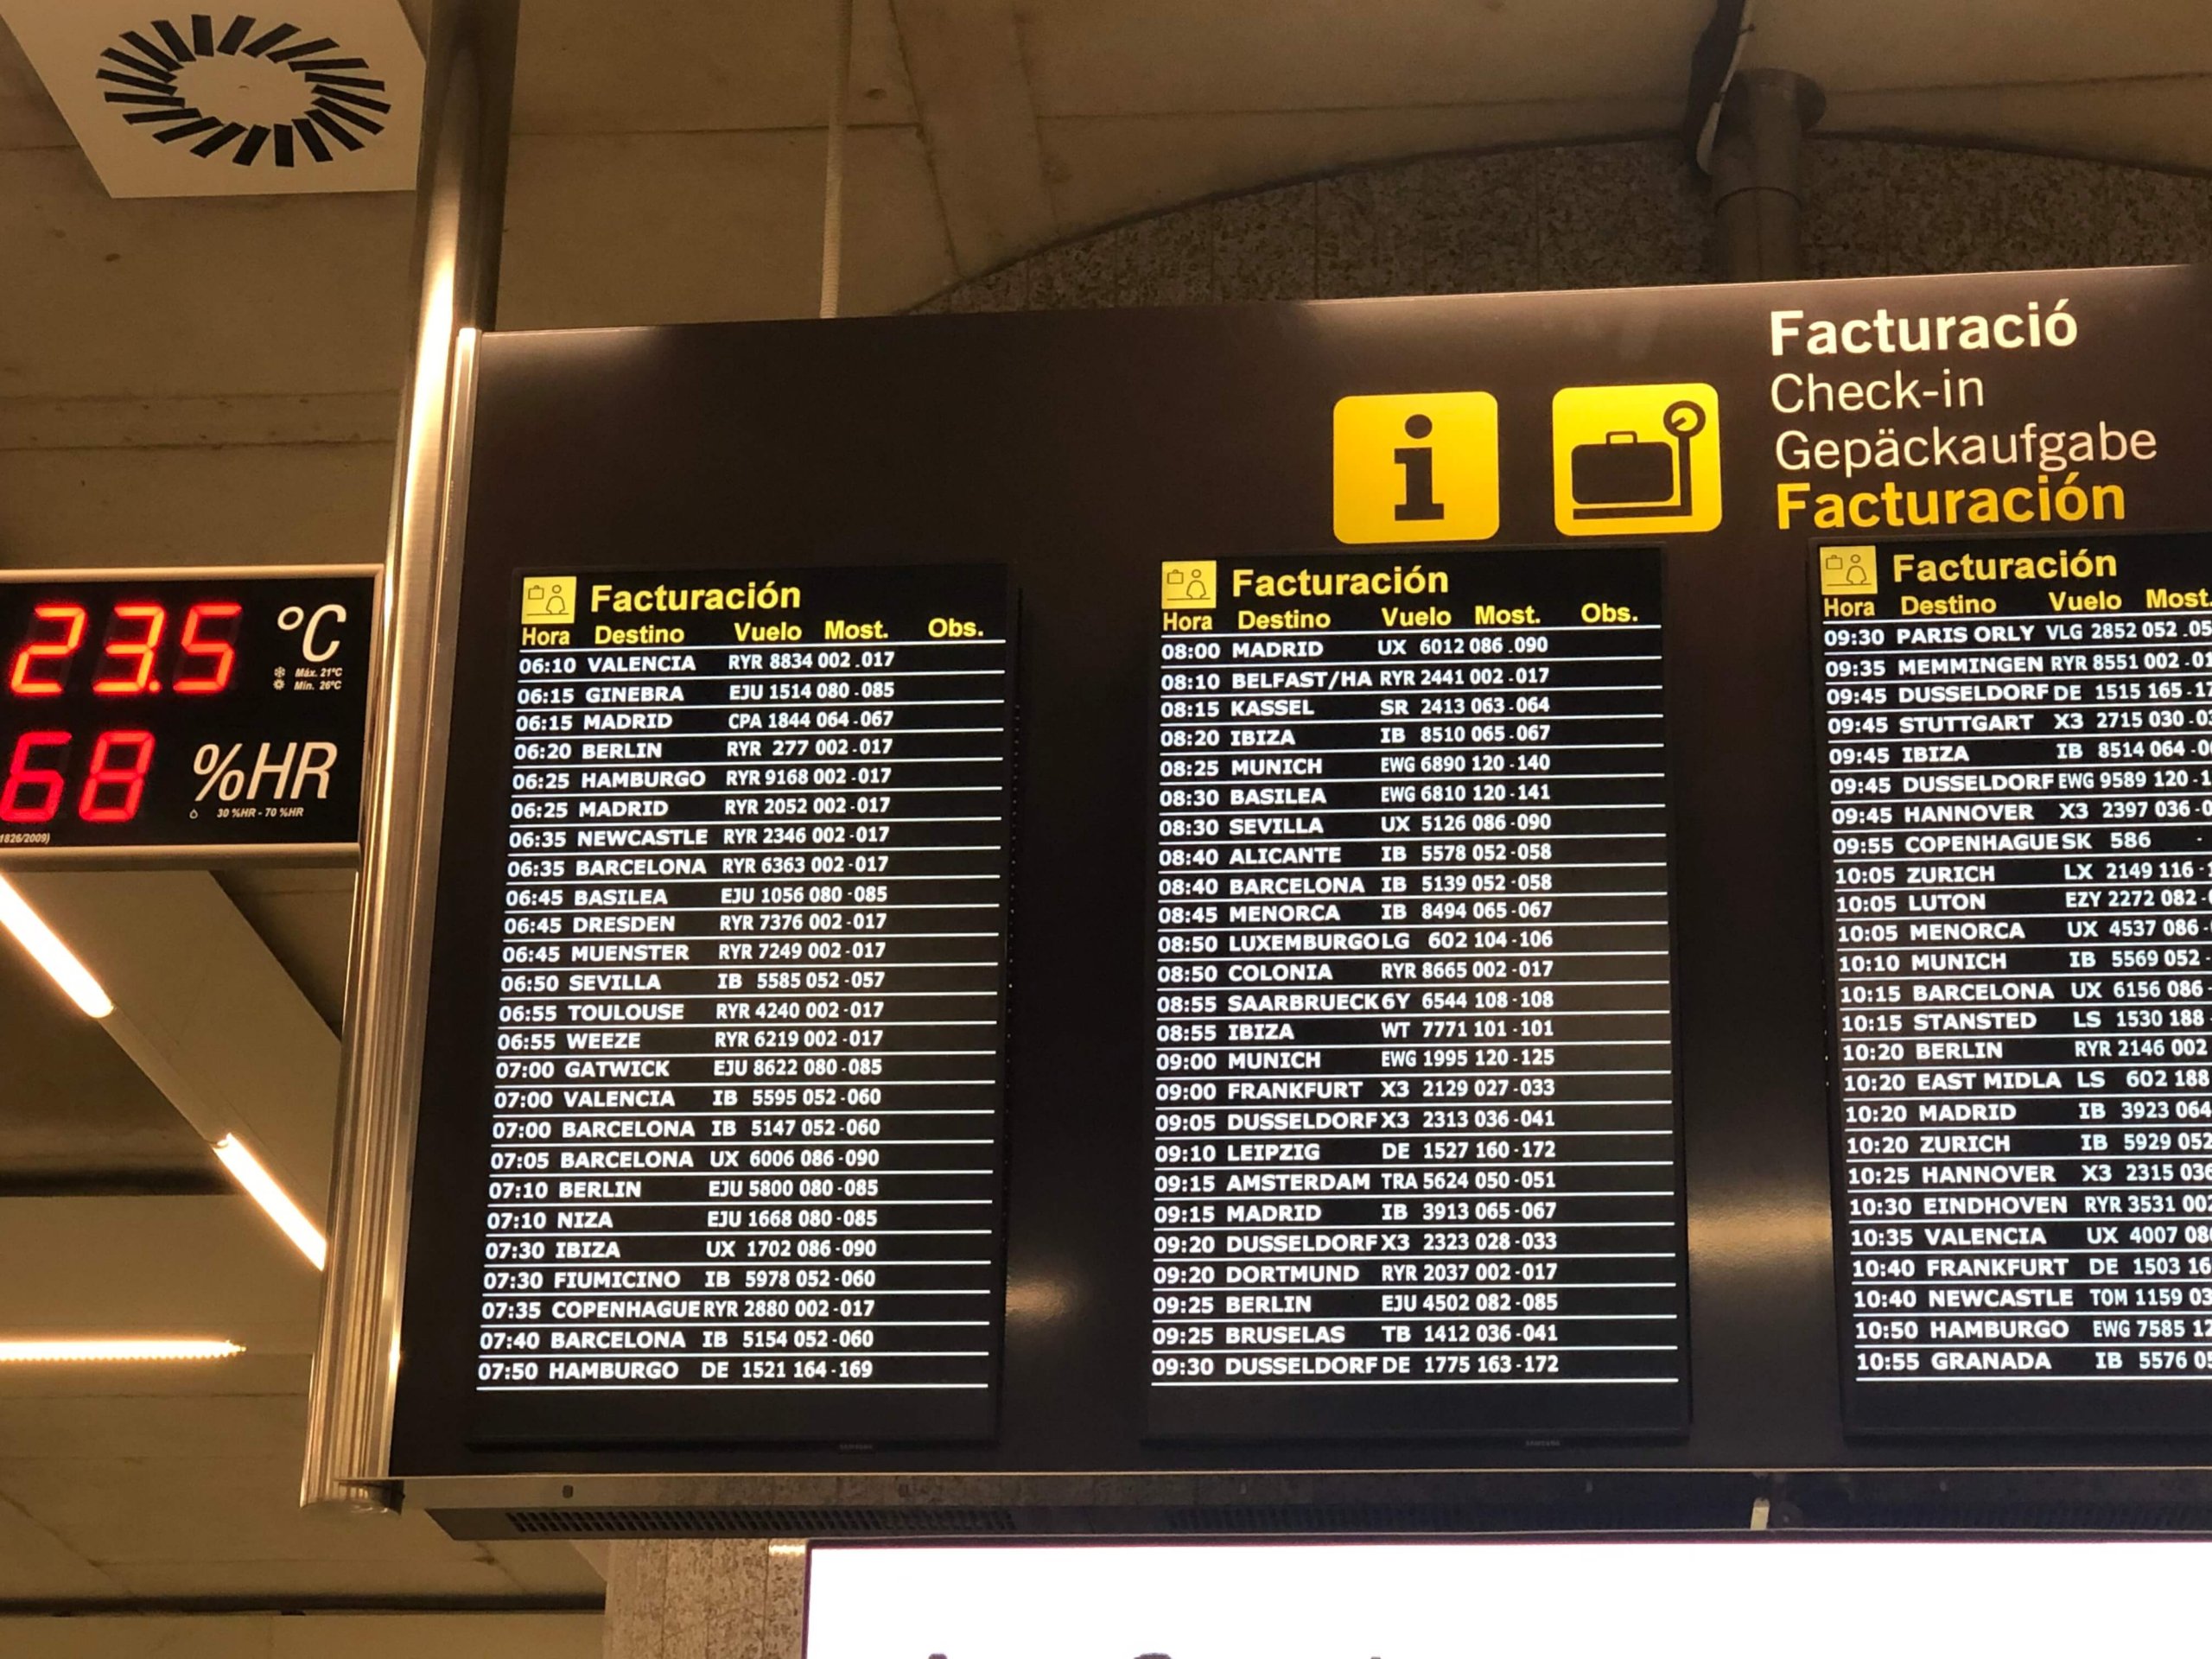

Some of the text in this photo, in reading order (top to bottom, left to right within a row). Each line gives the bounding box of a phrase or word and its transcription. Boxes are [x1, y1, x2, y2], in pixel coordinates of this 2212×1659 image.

[1770, 298, 2078, 356] Facturació
[1771, 368, 1983, 413] Check-in
[1777, 421, 2158, 478] Gepäckaufgabe
[1777, 472, 2124, 529] Facturación
[1894, 549, 2116, 582] Facturación
[1233, 565, 1447, 596] Facturación
[591, 581, 800, 612] Facturación
[1825, 598, 1875, 617] Hora
[1902, 594, 1996, 615] Destino
[2049, 591, 2121, 611] Vuelo
[1164, 603, 1637, 631] Hora Destino Vuelo Most. Obs.
[278, 604, 346, 662] °C
[523, 618, 983, 645] Hora Destino Vuelo Most. Obs.
[519, 653, 812, 674] 06:10 VALENCIA RYR 8834
[1826, 654, 2139, 677] 09:35 MEMMINGEN RYR 8551
[1161, 670, 1464, 690] 08:10 BELFAST/HA RYR 2441
[1828, 712, 2142, 734] 09:45 STUTTGART X3 2715
[1160, 726, 1465, 747] 08:20 IBIZA IB 8510
[515, 740, 809, 760] 06:20 BERLIN RYR 277
[0, 729, 156, 823] 68
[194, 742, 337, 801] %HR
[1160, 785, 1465, 806] 08:30 BASILEA EWG 6810
[217, 808, 230, 818] 30
[232, 808, 257, 818] %HR
[264, 807, 277, 817] 70
[279, 807, 304, 817] %HR
[1832, 802, 2148, 824] 09:45 HANNOVER X3 2397
[510, 827, 806, 848] 06:35 NEWCASTLE RYR 2346
[1834, 831, 2151, 855] 09:55 COPENHAGUE SK 586
[1160, 844, 1466, 866] 08:40 ALICANTE IB 5578
[506, 887, 804, 906] 06:45 BASILEA EJU 1056
[1837, 890, 2154, 912] 10:05 LUTON EZY 2272
[1158, 931, 1467, 953] 08:50 LUXEMBURGO LG 602
[501, 972, 801, 992] 06:50 SEVILLA IB 5585
[1841, 981, 2160, 1003] 10:15 BARCELONA UX 6156
[1158, 992, 1467, 1013] 08:55 SAARBRUECK 6Y 6544
[496, 1058, 798, 1078] 07:00 GATWICK EJU 8622
[1156, 1079, 1468, 1101] 09:00 FRANKFURT X3 2129
[1845, 1070, 2167, 1091] 10:20 EAST MIDLA LS 602
[491, 1150, 794, 1169] 07:05 BARCELONA UX 6006
[1155, 1172, 1469, 1192] 09:15 AMSTERDAM TRA 5624
[1849, 1164, 2173, 1185] 10:25 HANNOVER X3 2315
[487, 1210, 791, 1230] 07:10 NIZA EJU 1668
[1154, 1264, 1469, 1284] 09:20 DORTMUND RYR 2037
[1853, 1257, 2180, 1277] 10:40 FRANKFURT DE 1503
[482, 1300, 789, 1319] 07:35 COPENHAGUE RYR 2880
[1153, 1325, 1470, 1344] 09:25 BRUSELAS TB 1412
[1856, 1319, 2185, 1339] 10:50 HAMBURGO EWG 7585
[479, 1361, 785, 1380] 07:50 HAMBURGO DE 1521
